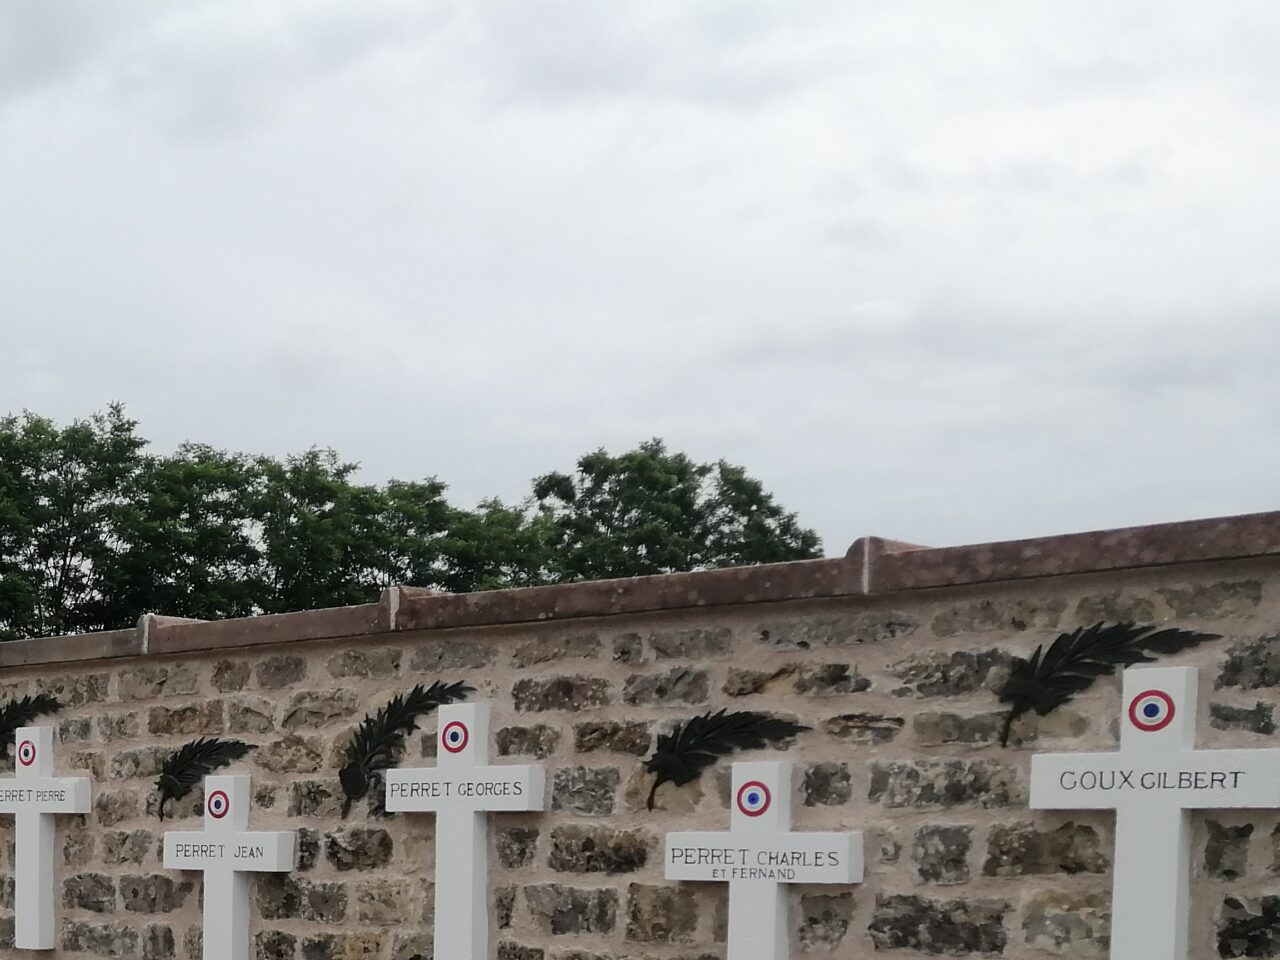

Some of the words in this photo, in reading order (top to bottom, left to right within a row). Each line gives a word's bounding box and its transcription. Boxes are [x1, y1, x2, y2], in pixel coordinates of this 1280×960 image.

[1060, 770, 1135, 791] GOUX
[1140, 771, 1246, 790] GILBERT
[35, 790, 66, 802] PIERRE
[390, 782, 452, 798] PERRET
[457, 781, 523, 796] GEORGES
[175, 844, 226, 858] PERRET
[233, 846, 264, 858] JEAN
[671, 848, 749, 865] PERRET
[756, 851, 840, 867] CHARLES
[712, 869, 726, 879] ET
[732, 868, 796, 880] FERNAND
